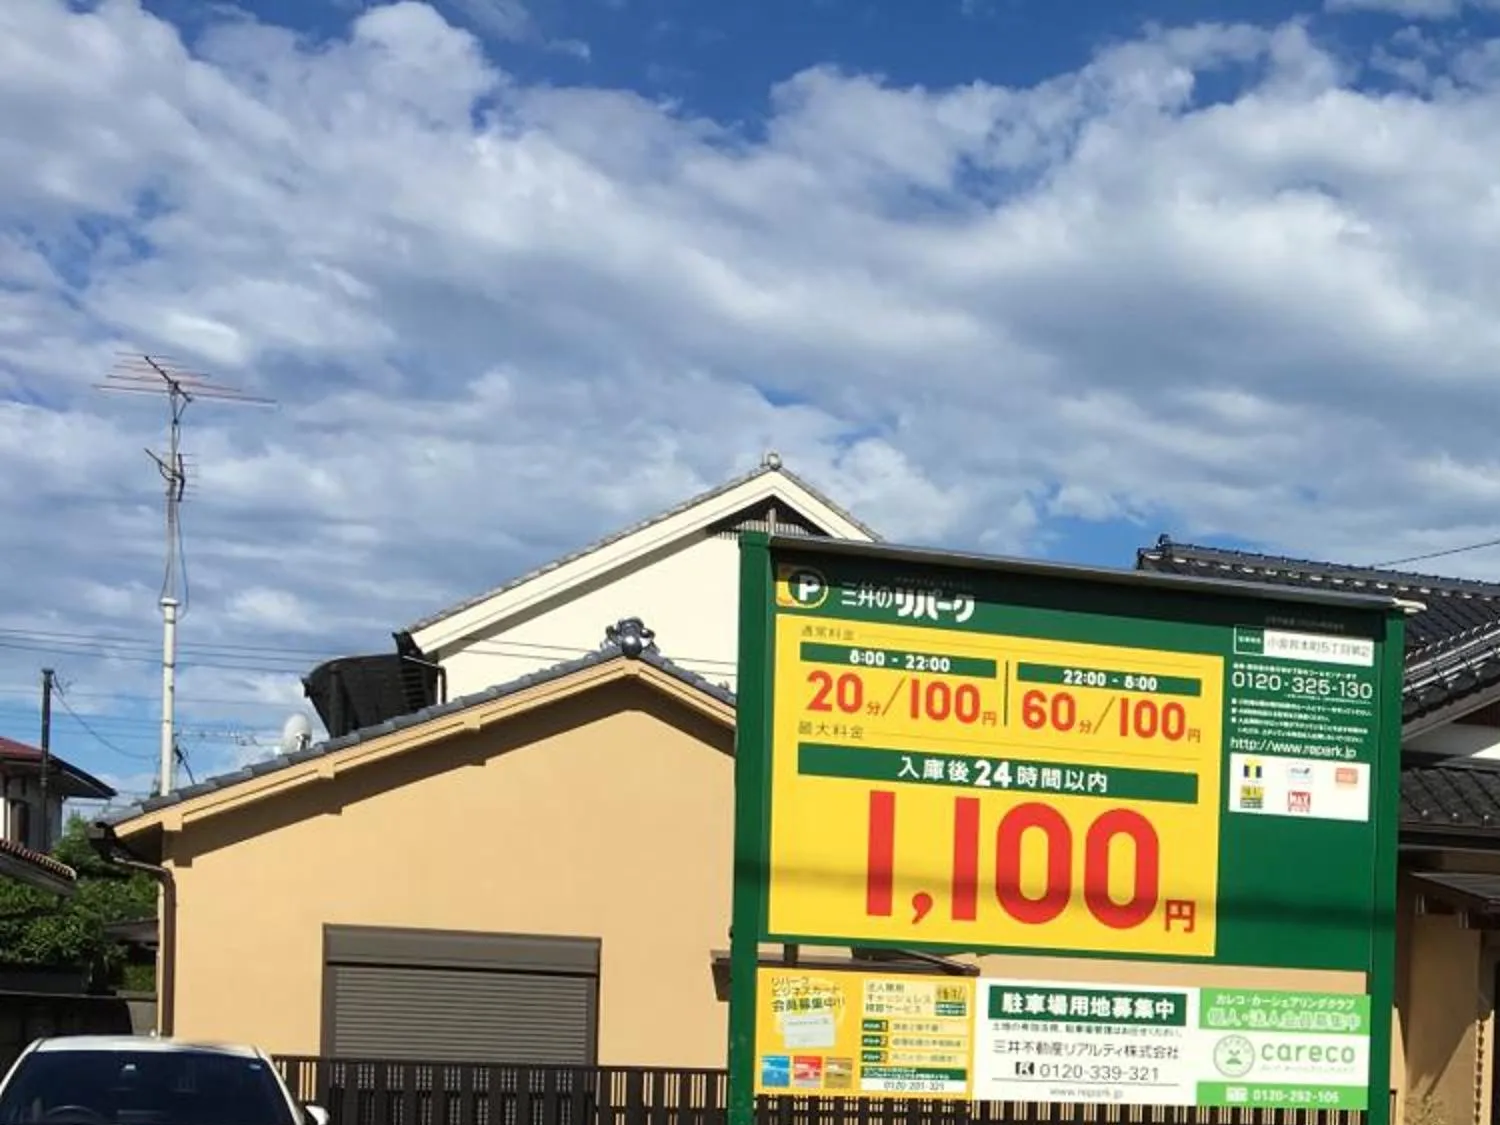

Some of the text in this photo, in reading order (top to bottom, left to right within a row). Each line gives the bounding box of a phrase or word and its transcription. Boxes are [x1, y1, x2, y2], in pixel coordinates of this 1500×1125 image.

[841, 581, 976, 623] 三井のリパーク
[849, 650, 885, 667] 8:00
[905, 655, 951, 673] 22:00
[1063, 669, 1107, 688] 22:00
[1124, 674, 1158, 692] 8:00
[1002, 992, 1175, 1020] 駐車場用地募集中
[1260, 1042, 1356, 1064] careco
[1039, 1063, 1160, 1081] 0120-339-321
